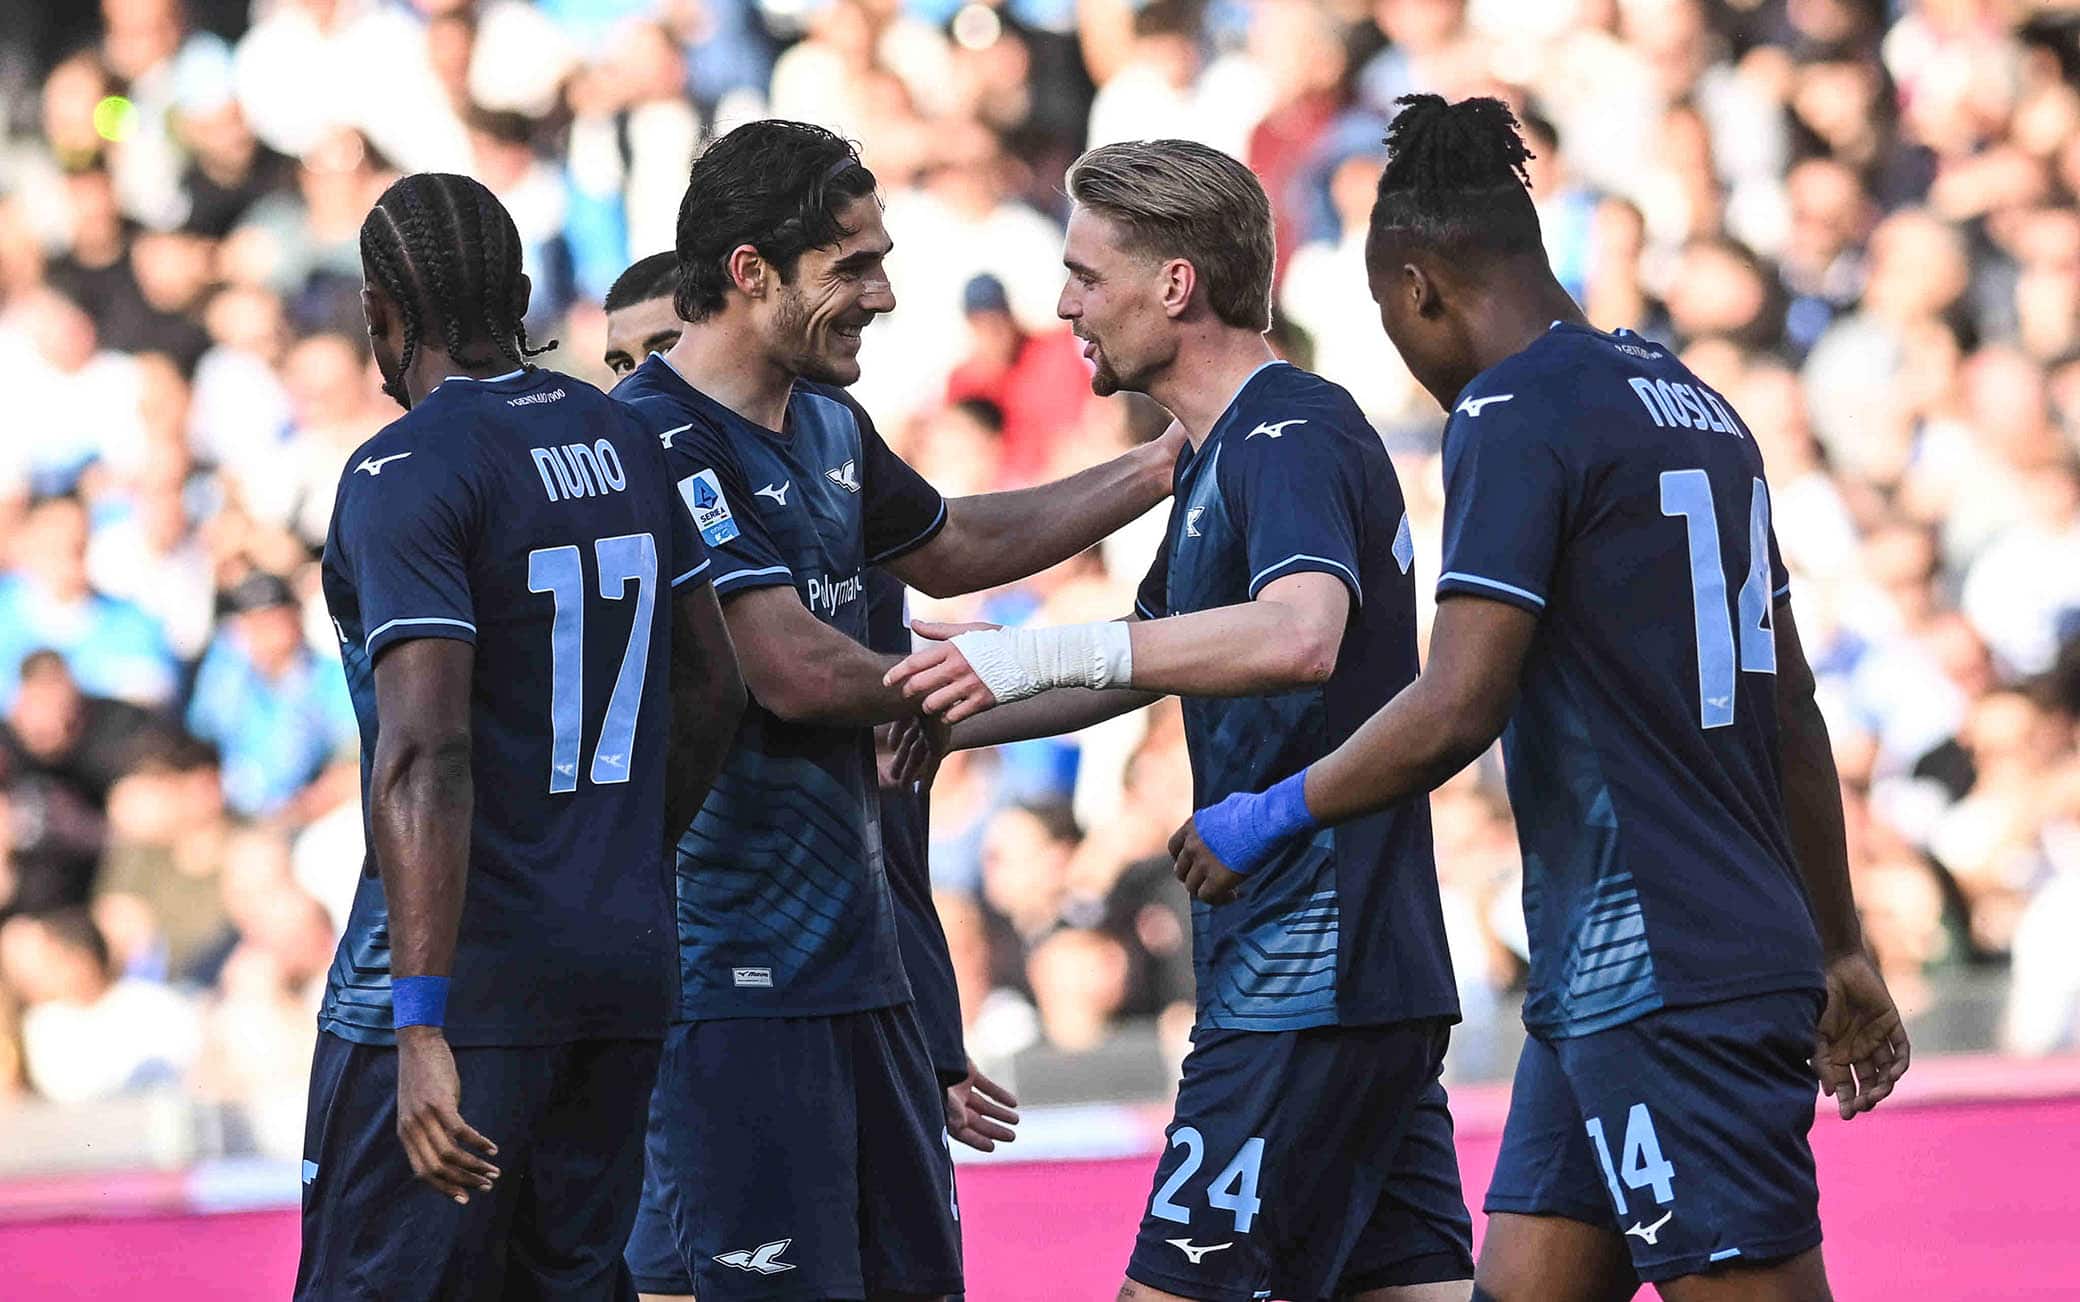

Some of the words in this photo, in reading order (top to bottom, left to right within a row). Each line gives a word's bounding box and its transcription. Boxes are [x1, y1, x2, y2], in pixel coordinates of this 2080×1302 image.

[528, 533, 658, 794] 17
[1660, 469, 1777, 730] 14
[1150, 1126, 1265, 1234] 24
[1587, 1103, 1676, 1215] 14
